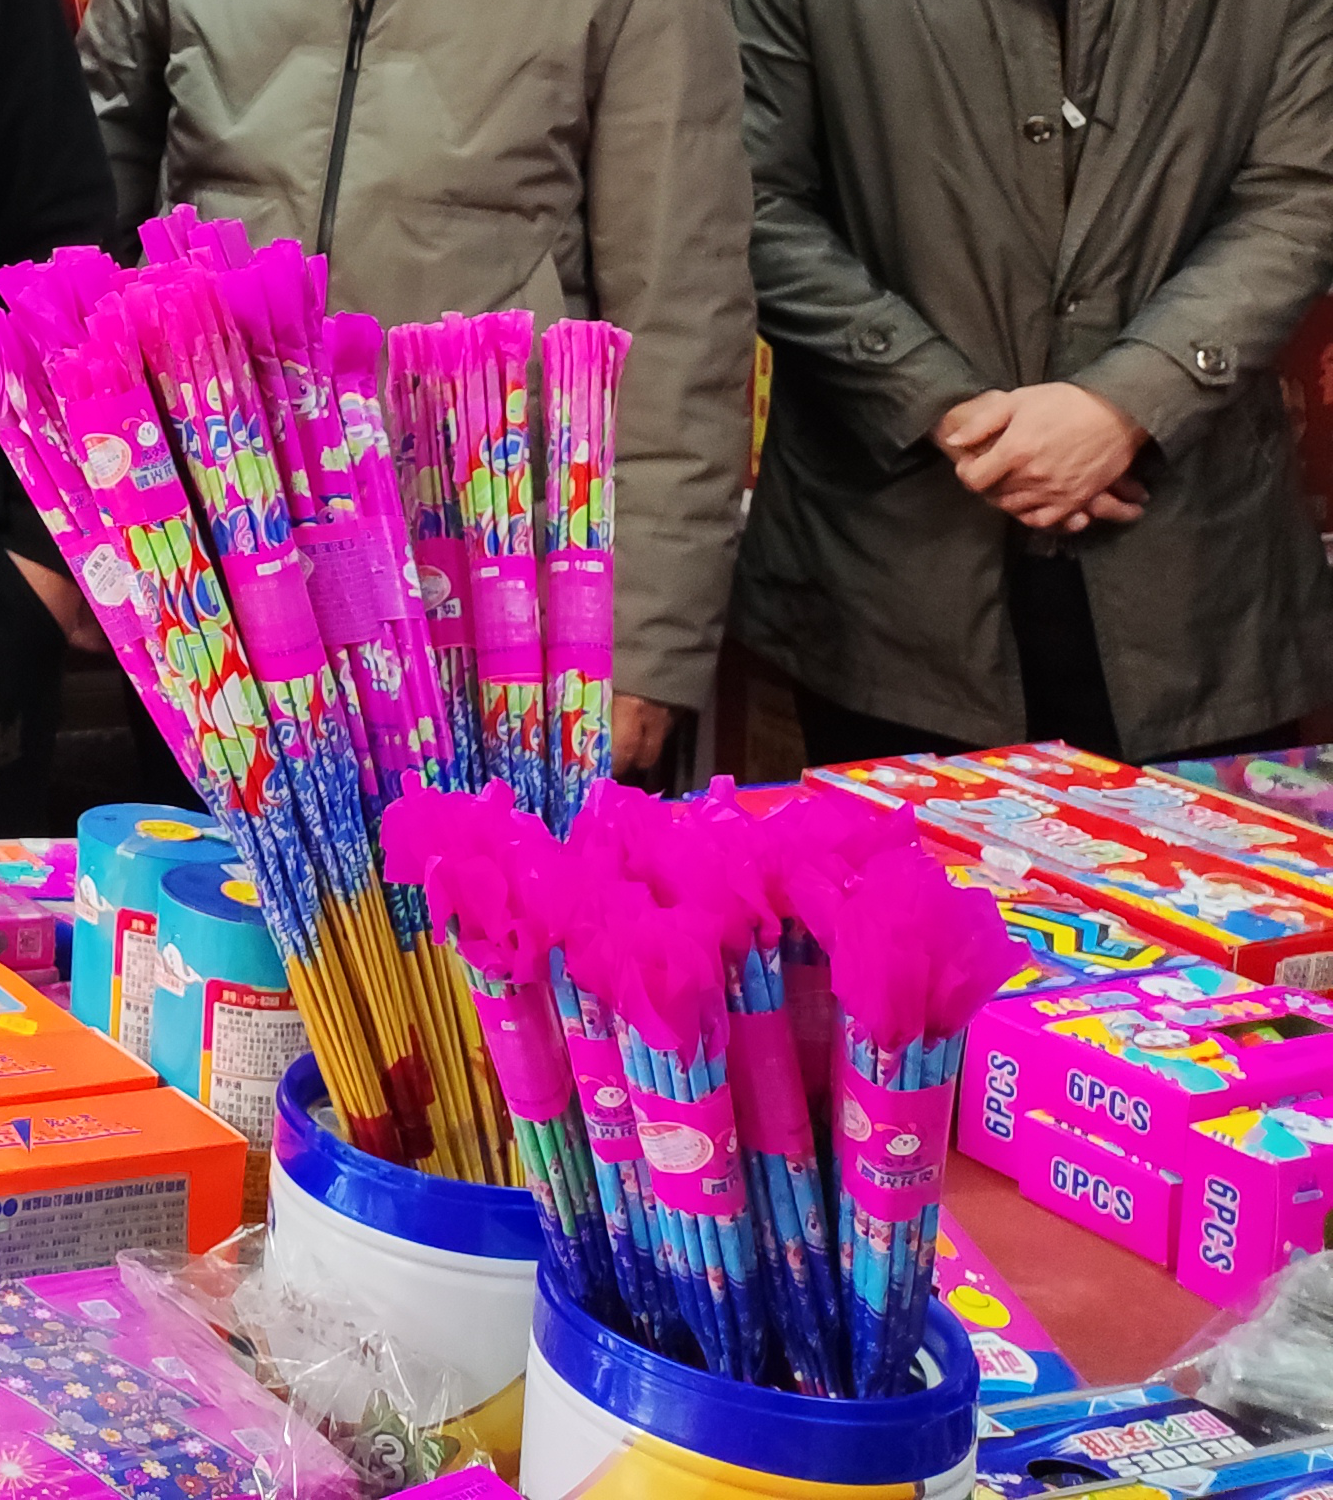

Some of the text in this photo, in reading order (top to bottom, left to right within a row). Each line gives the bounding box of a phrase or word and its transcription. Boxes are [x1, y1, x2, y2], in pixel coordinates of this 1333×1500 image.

[984, 1051, 1018, 1141] 6PCS
[1068, 1070, 1151, 1134] 6PCS
[1052, 1156, 1134, 1224] 6PCS
[1201, 1176, 1240, 1273] 6PCS
